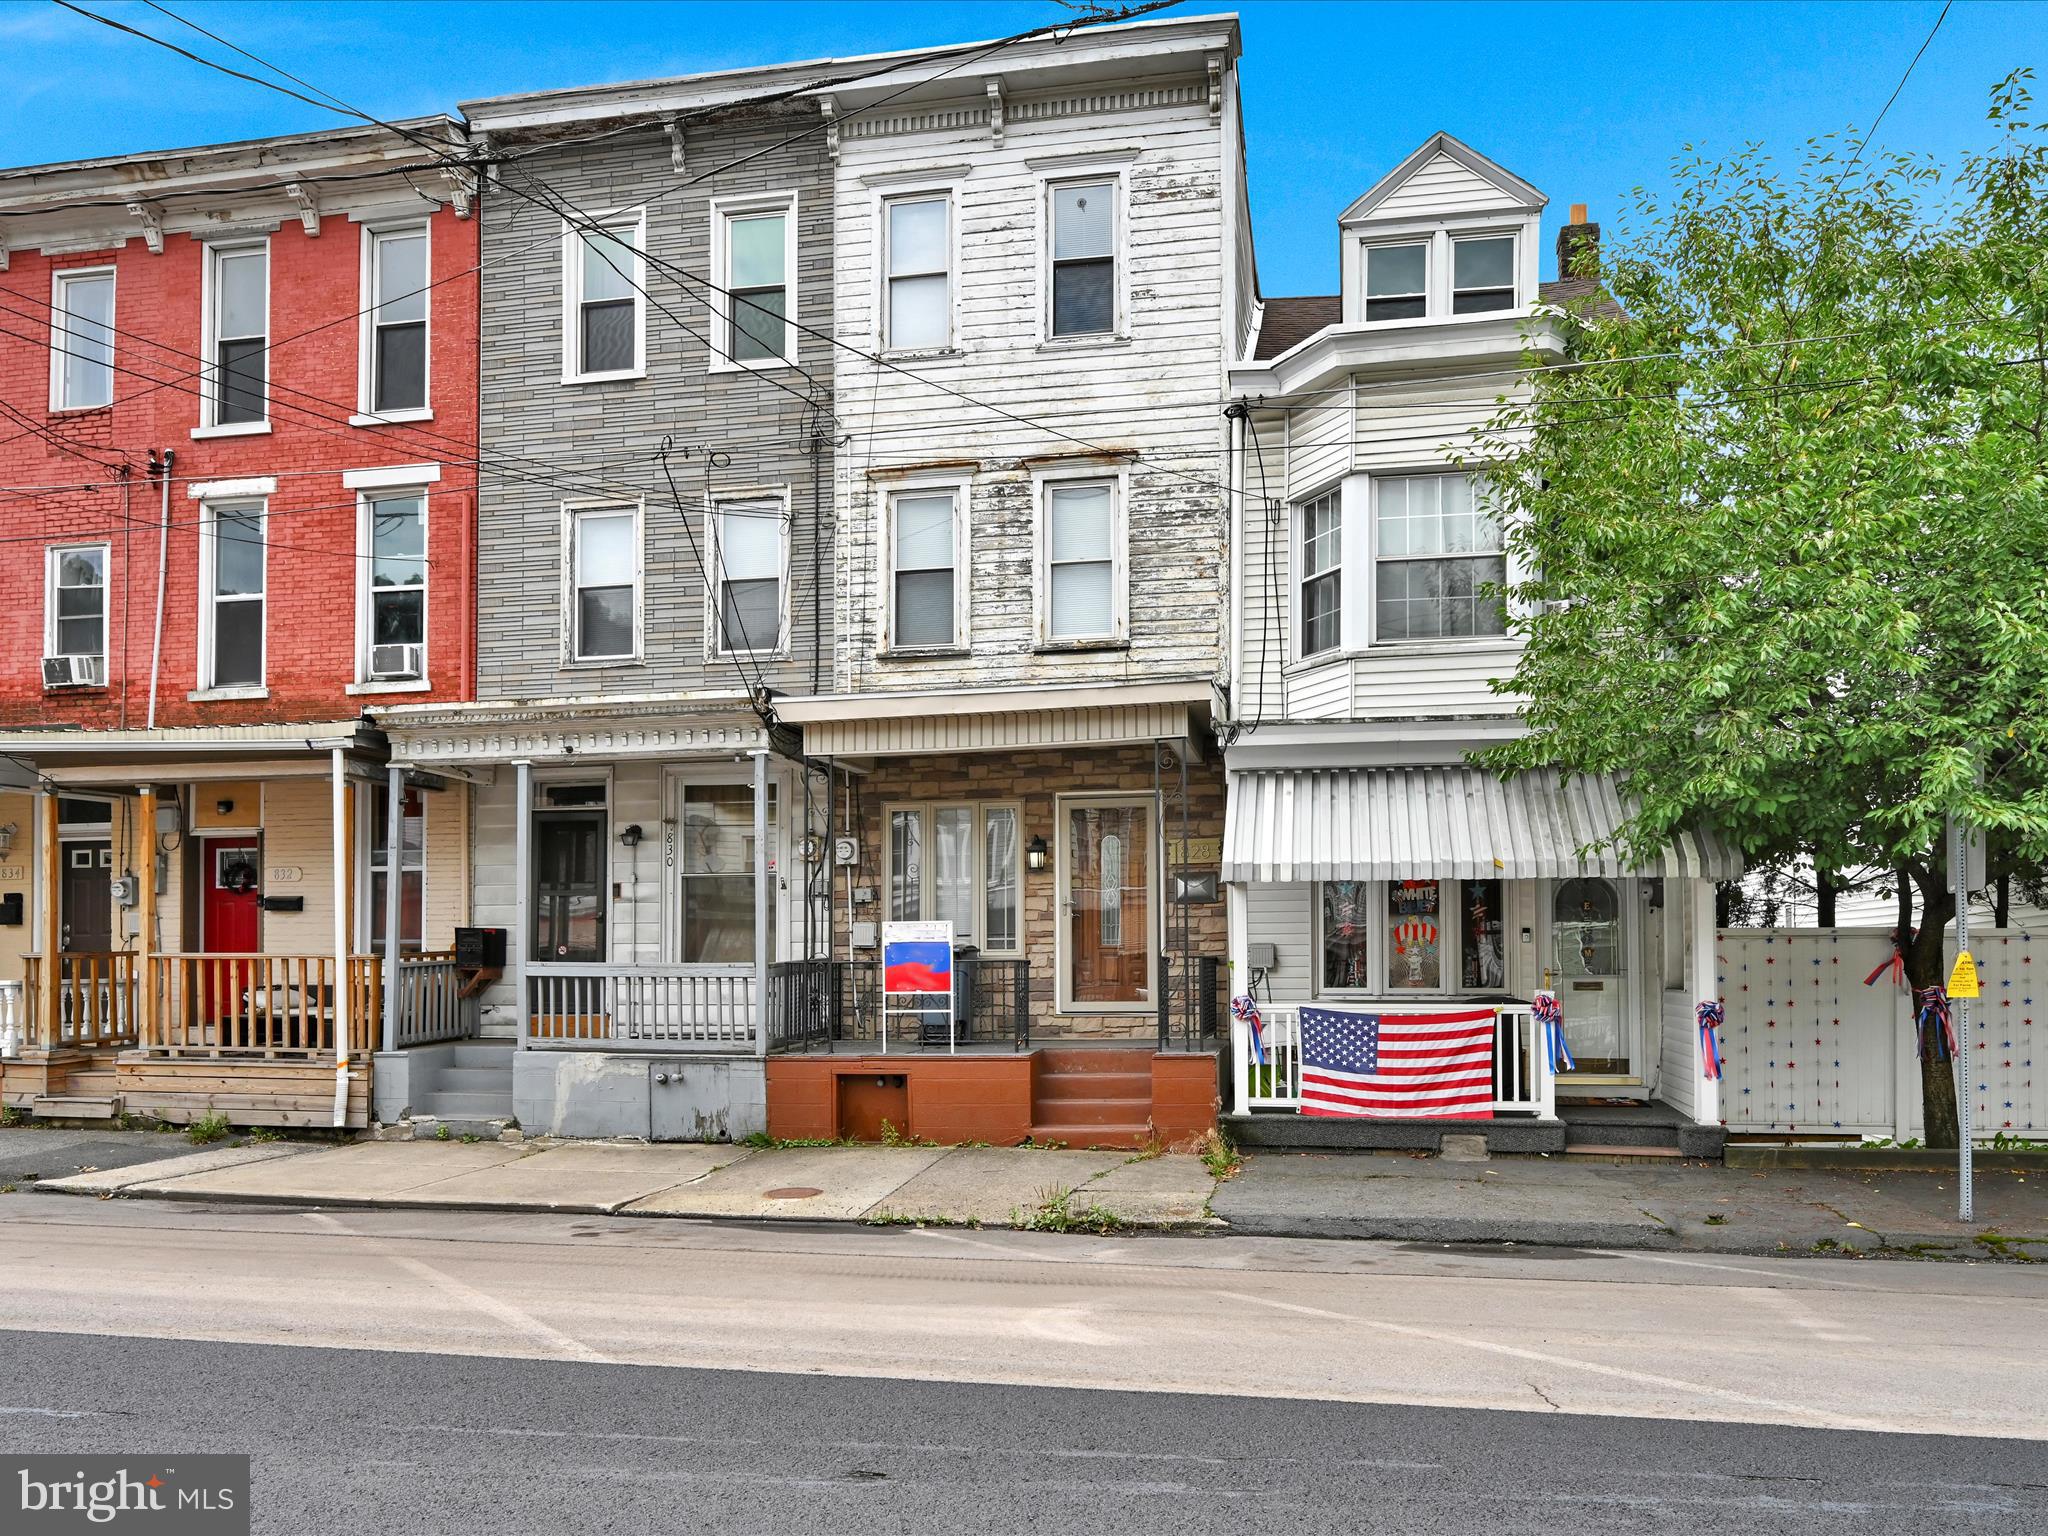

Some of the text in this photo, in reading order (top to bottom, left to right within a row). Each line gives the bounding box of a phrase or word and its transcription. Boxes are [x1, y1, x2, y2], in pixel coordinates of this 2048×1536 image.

[666, 832, 674, 867] 830
[1, 867, 20, 879] 834
[274, 869, 293, 880] 832
[1401, 886, 1438, 901] WHITE
